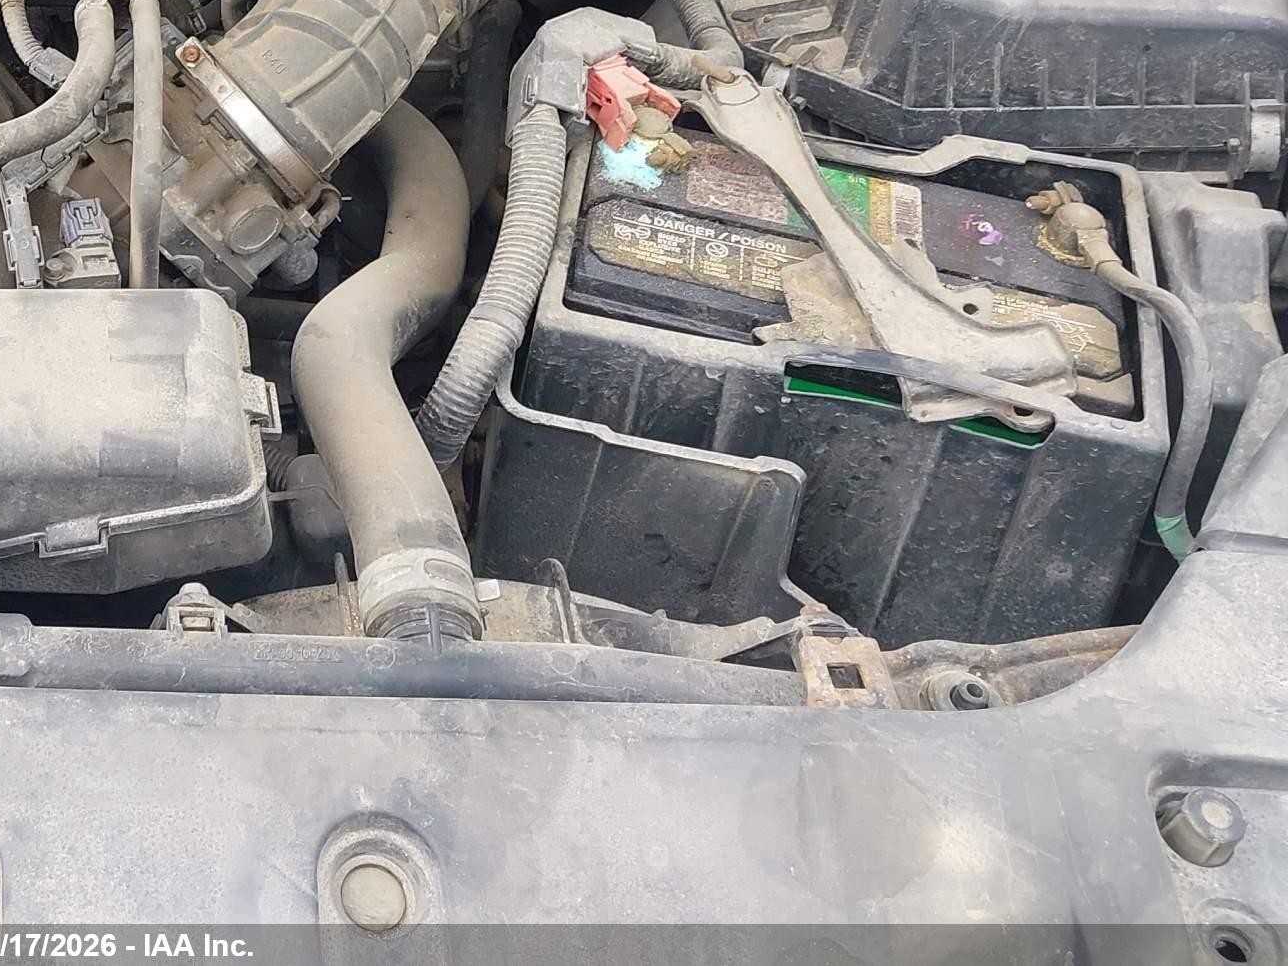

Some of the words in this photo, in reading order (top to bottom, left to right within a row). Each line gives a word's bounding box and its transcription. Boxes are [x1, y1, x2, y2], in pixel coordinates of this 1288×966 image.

[653, 216, 716, 238] DANGER
[717, 224, 729, 240] /
[730, 234, 787, 254] POISON
